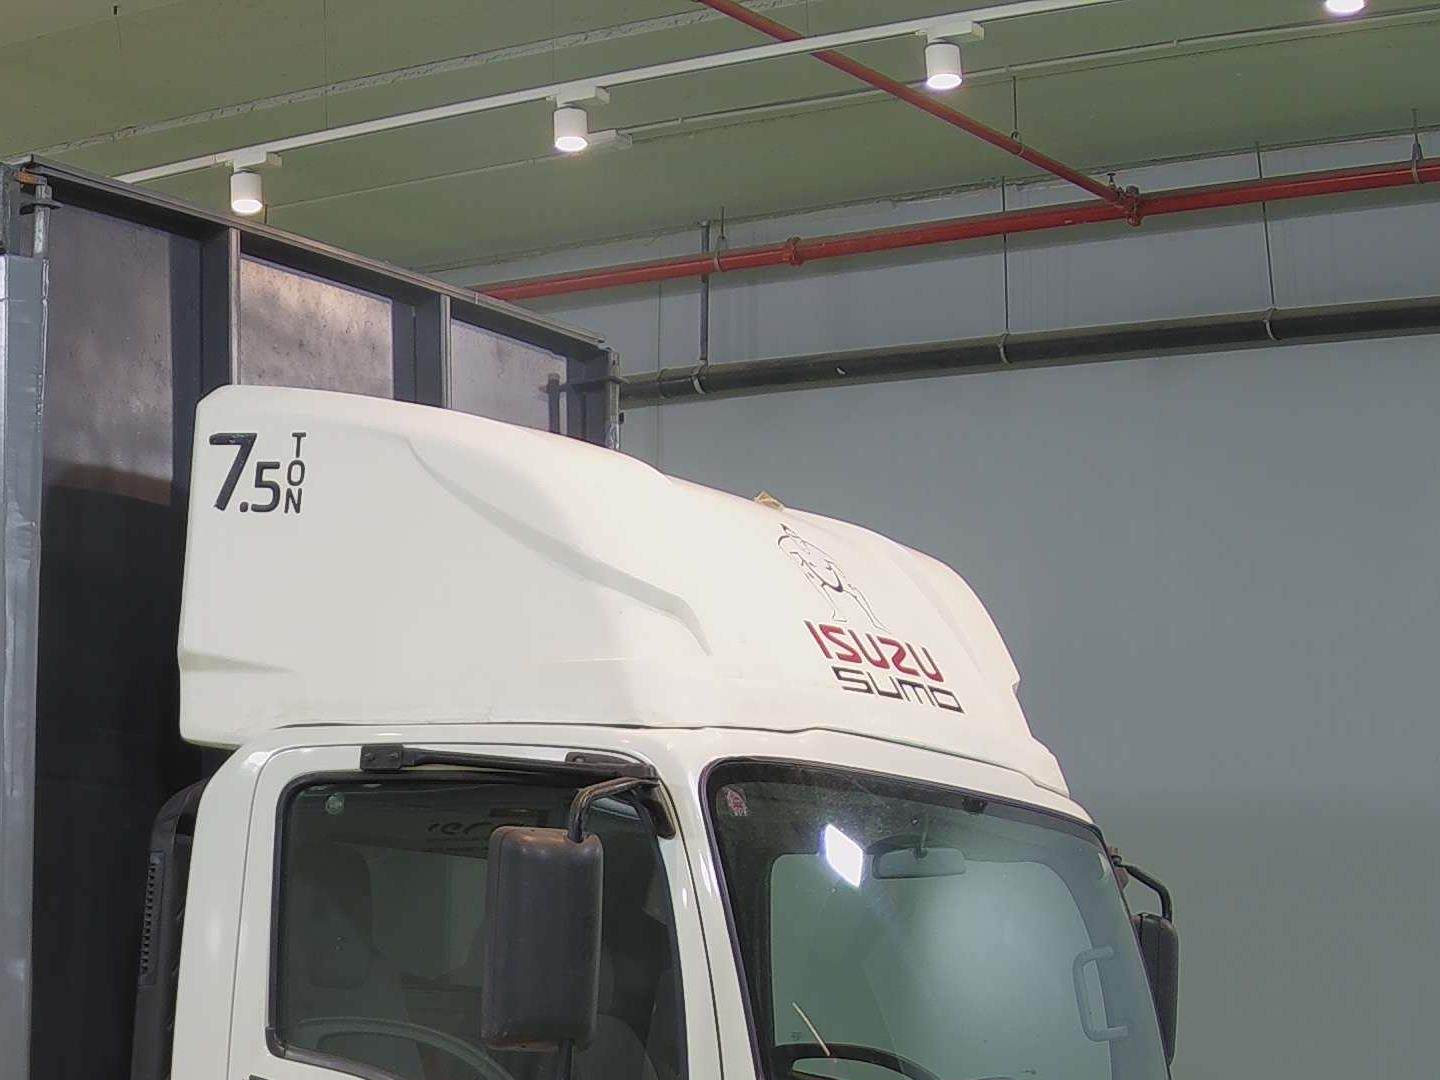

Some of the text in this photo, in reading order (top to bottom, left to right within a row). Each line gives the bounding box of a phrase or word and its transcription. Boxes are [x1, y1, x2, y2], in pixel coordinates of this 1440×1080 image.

[209, 432, 307, 514] 7.5 TON
[803, 620, 944, 683] ISUZU
[831, 665, 965, 714] SUMO
